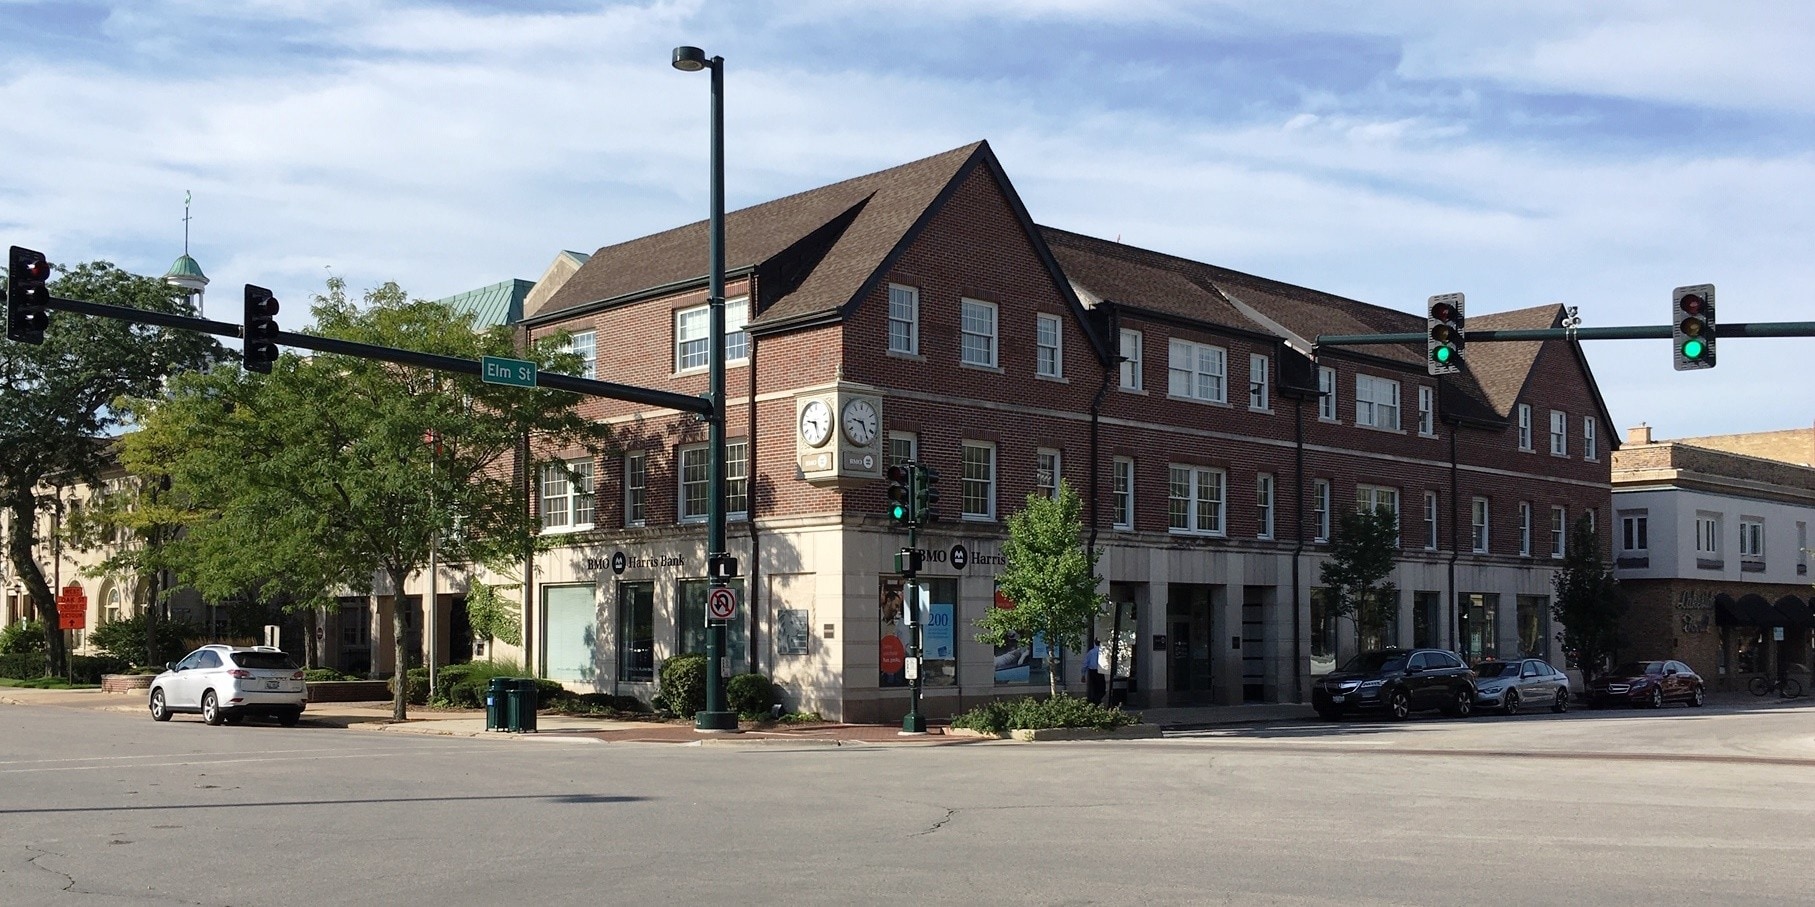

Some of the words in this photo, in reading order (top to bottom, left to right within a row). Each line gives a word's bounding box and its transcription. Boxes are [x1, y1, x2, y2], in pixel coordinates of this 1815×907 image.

[487, 363, 511, 378] Elm
[518, 367, 531, 381] St
[849, 458, 863, 466] BMO
[587, 558, 610, 570] BMO
[628, 556, 659, 569] Harris
[660, 553, 685, 567] Bank
[971, 551, 1006, 565] Harris
[928, 614, 948, 626] 200
